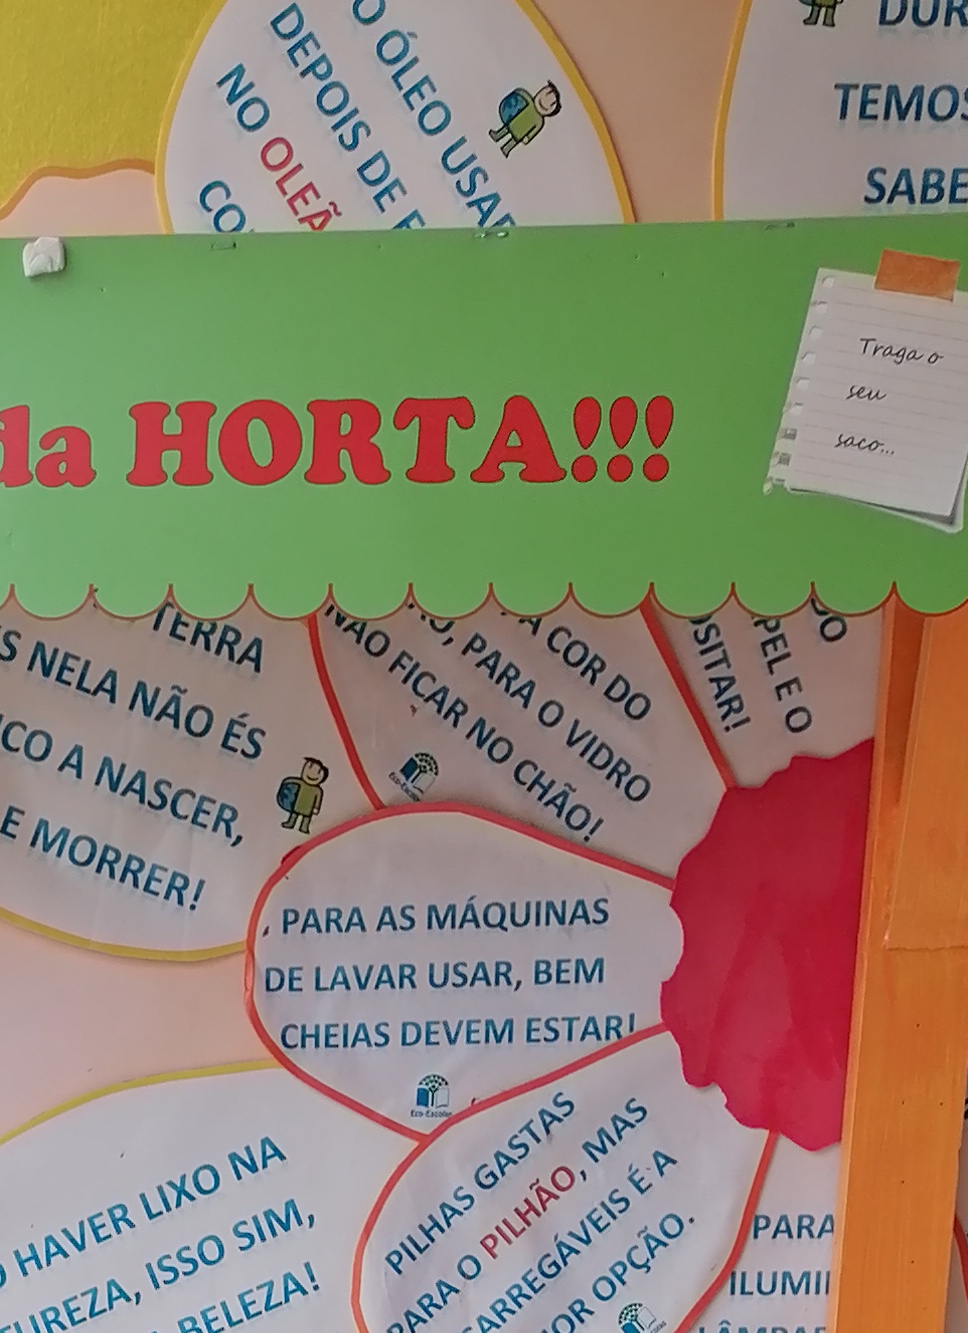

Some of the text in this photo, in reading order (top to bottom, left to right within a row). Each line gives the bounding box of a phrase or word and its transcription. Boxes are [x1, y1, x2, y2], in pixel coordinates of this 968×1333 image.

[216, 63, 270, 132] NO
[270, 2, 408, 213] DEPOIS DE
[376, 29, 452, 136] ÓLEO
[834, 83, 968, 121] TEMO
[199, 180, 256, 233] CO
[846, 385, 886, 400] seu
[860, 338, 944, 364] Traga o
[127, 394, 674, 486] HORTA!!!
[834, 433, 895, 455] saco...
[27, 641, 117, 704] NELA
[129, 685, 214, 738] NÃO
[220, 713, 266, 759] ÉS
[461, 632, 652, 803] PARA O VIDRO
[547, 627, 604, 686] COR
[604, 674, 652, 721] DO
[751, 616, 812, 733] PEL E O
[388, 650, 469, 728] FICAR
[466, 717, 514, 764] NO
[513, 759, 604, 843] CHÃO!
[57, 745, 83, 779] A
[95, 756, 243, 846] NASCER,
[0, 806, 25, 839] E
[29, 819, 206, 911] MORRER!
[281, 896, 610, 935] PARA AS MÁQUINAS
[265, 957, 605, 992] DE LAVAR USAR, BEM
[280, 1013, 635, 1050] CHEIAS DEVEM ESTAR!
[13, 1202, 136, 1277] HAVER
[138, 1163, 221, 1221] LIXO
[228, 1136, 287, 1181] NA
[385, 1092, 576, 1276] PILHAS GASTAS
[458, 1254, 482, 1281] O
[480, 1165, 588, 1260] PILHÃO,
[582, 1098, 648, 1163] MAS
[627, 1165, 652, 1195] É
[651, 1150, 678, 1178] A
[145, 1234, 225, 1291] ISSO
[232, 1198, 316, 1252] SIM,
[591, 1212, 696, 1303] OPÇÃO.
[752, 1214, 834, 1240] PARA
